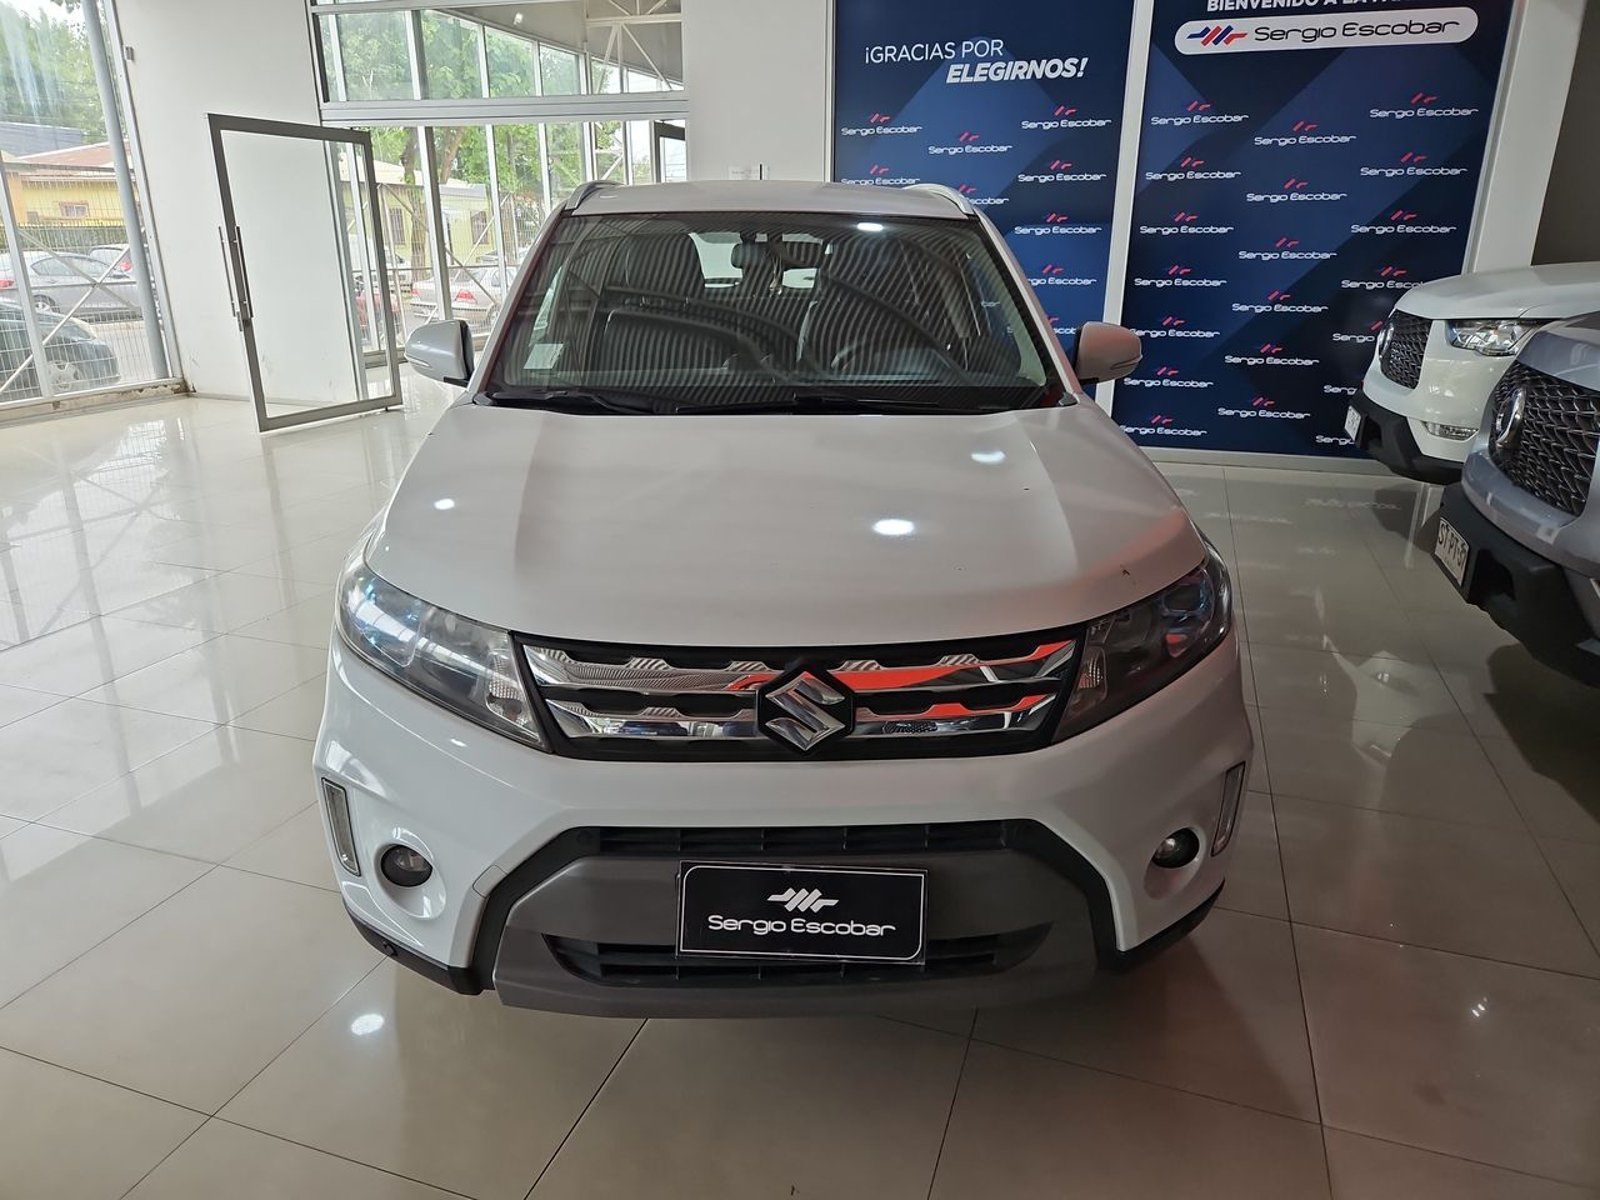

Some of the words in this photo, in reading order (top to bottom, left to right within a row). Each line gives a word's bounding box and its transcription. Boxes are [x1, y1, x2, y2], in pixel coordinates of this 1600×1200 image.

[1254, 26, 1337, 44] Sergio
[1341, 19, 1460, 37] Escobar
[865, 42, 956, 64] ¡GRACIAS
[961, 39, 1004, 57] POR
[946, 57, 1088, 84] ELEGIRNOS!
[1369, 108, 1413, 119] Sergio
[1411, 107, 1479, 117] Escobar
[1021, 120, 1060, 130] Sergio
[1059, 119, 1112, 128] Escobar
[1150, 116, 1192, 126] Sergio
[1192, 114, 1249, 124] Escobar
[841, 127, 876, 137] Sergio
[875, 125, 923, 134] Escobar
[1254, 136, 1297, 147] Sergio
[1298, 135, 1357, 145] Escobar
[928, 145, 964, 156] Sergio
[964, 144, 1013, 153] Escobar
[1145, 171, 1186, 182] Sergio
[1186, 170, 1242, 180] Escobar
[1360, 167, 1405, 177] Sergio
[1406, 166, 1468, 176] Escobar
[874, 177, 921, 185] Escobar
[1017, 174, 1055, 184] Sergio
[1055, 173, 1107, 181] Escobar
[1246, 193, 1289, 203] Sergio
[1289, 192, 1348, 201] Escobar
[1014, 226, 1051, 236] Sergio
[1051, 225, 1103, 234] Escobar
[1139, 225, 1180, 236] Sergio
[1179, 225, 1235, 234] Escobar
[1350, 224, 1396, 235] Sergio
[1396, 224, 1457, 234] Escobar
[1238, 250, 1280, 261] Sergio
[1280, 250, 1338, 260] Escobar
[1028, 277, 1047, 287] rgio
[1047, 276, 1097, 286] Escobar
[1134, 277, 1173, 288] Sergio
[1173, 278, 1227, 287] Escobar
[1341, 279, 1385, 290] Sergio
[1231, 303, 1273, 314] Sergio
[1273, 303, 1329, 313] Escobar
[1167, 328, 1221, 338] Escobar
[1332, 333, 1376, 344] Sergio
[1224, 355, 1265, 366] Sergio
[1265, 356, 1320, 366] Escobar
[1123, 377, 1162, 388] Sergio
[1162, 378, 1214, 388] Escobar
[1217, 407, 1257, 418] Sergio
[1258, 409, 1311, 420] Escobar
[1156, 426, 1208, 436] Escobar
[707, 914, 787, 936] Sergio
[790, 917, 896, 937] Escobar
